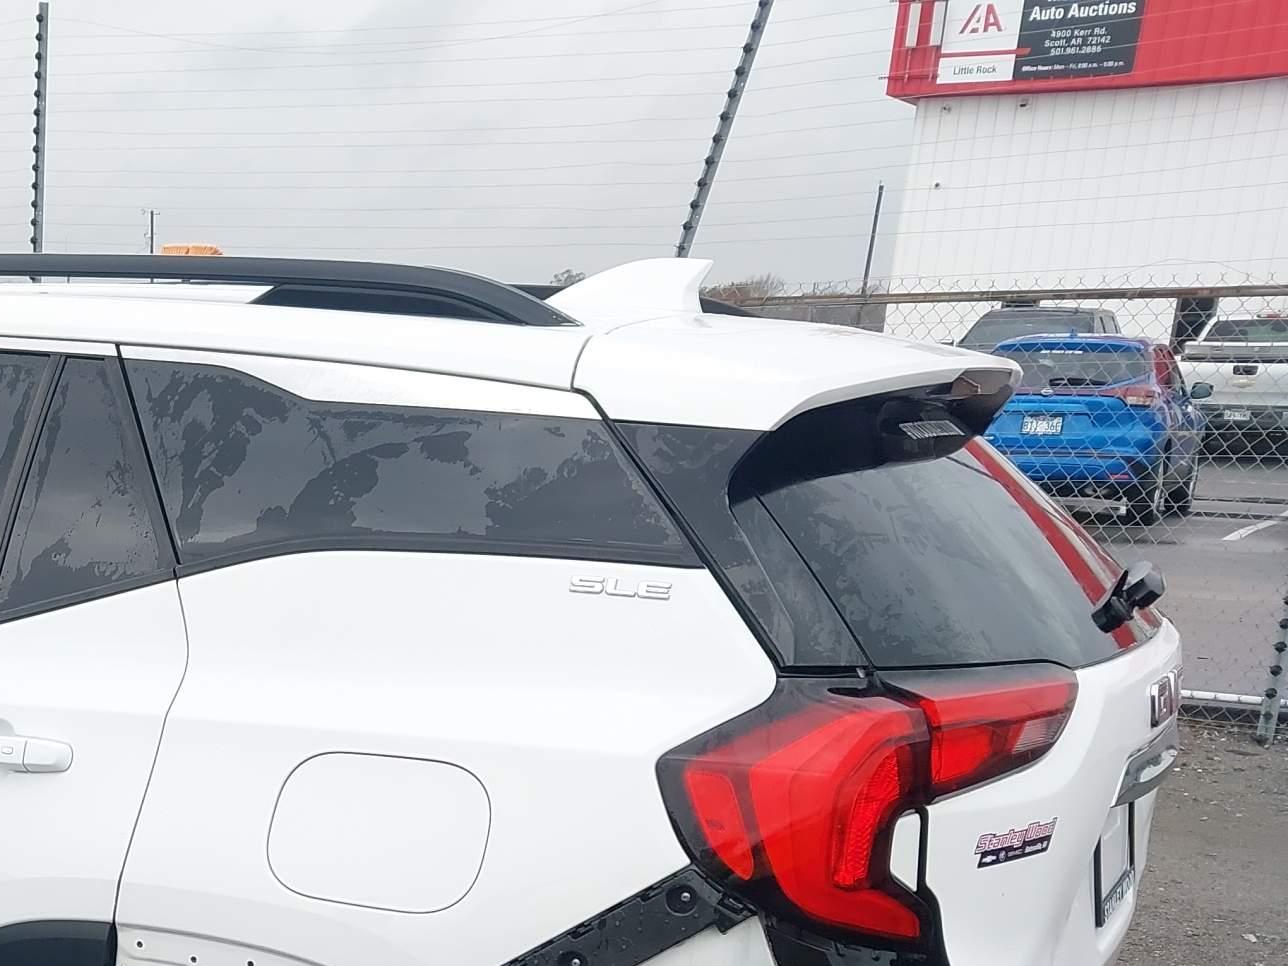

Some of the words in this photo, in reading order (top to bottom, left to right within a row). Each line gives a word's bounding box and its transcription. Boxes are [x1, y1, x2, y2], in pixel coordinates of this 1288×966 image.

[1029, 6, 1064, 21] Auto
[1067, 1, 1137, 18] Auctions
[1051, 29, 1072, 38] 4900
[1073, 28, 1092, 37] Kerr
[1093, 27, 1107, 35] Rd.
[1070, 38, 1082, 46] AR
[1087, 35, 1112, 44] 72142
[953, 66, 974, 76] Little
[975, 65, 997, 74] Rock
[568, 576, 672, 600] SLE
[975, 829, 1027, 855] Stanley
